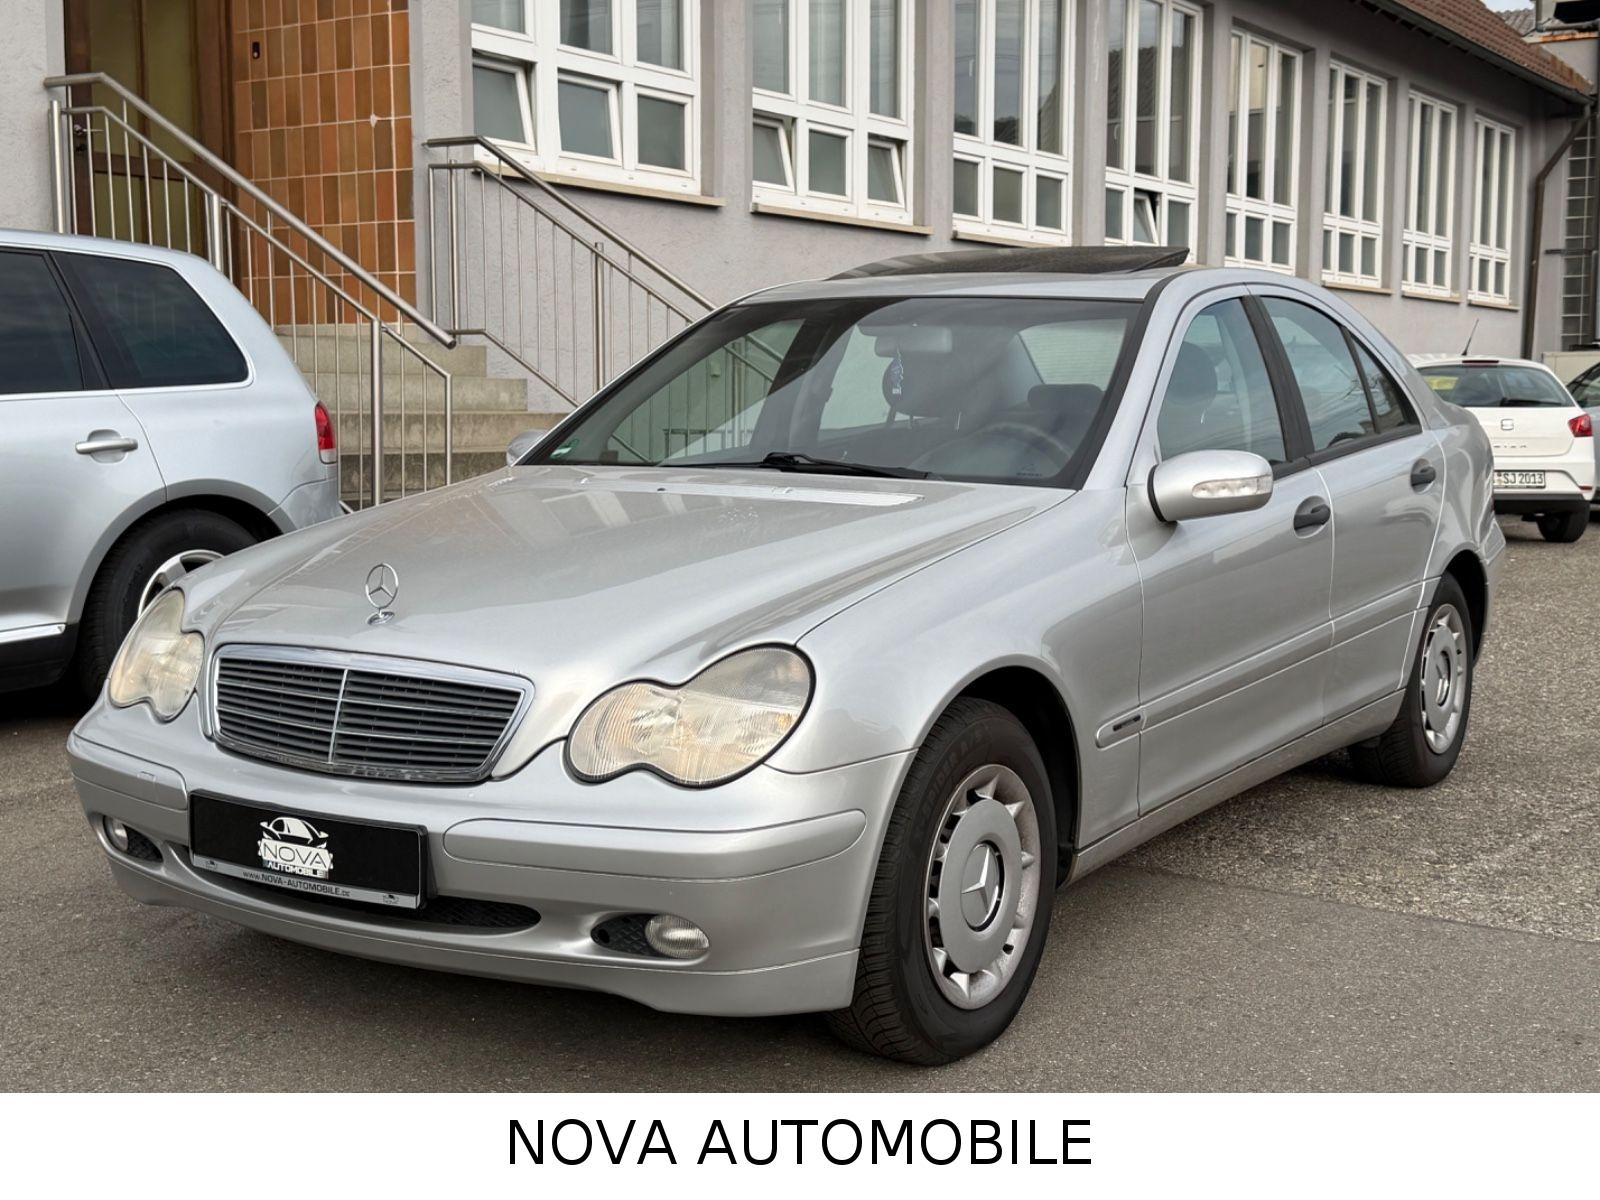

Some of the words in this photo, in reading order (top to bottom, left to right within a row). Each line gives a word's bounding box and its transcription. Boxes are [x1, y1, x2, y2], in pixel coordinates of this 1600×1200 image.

[1503, 473, 1516, 484] SJ
[1518, 473, 1543, 484] 2013
[263, 842, 327, 869] NOVA
